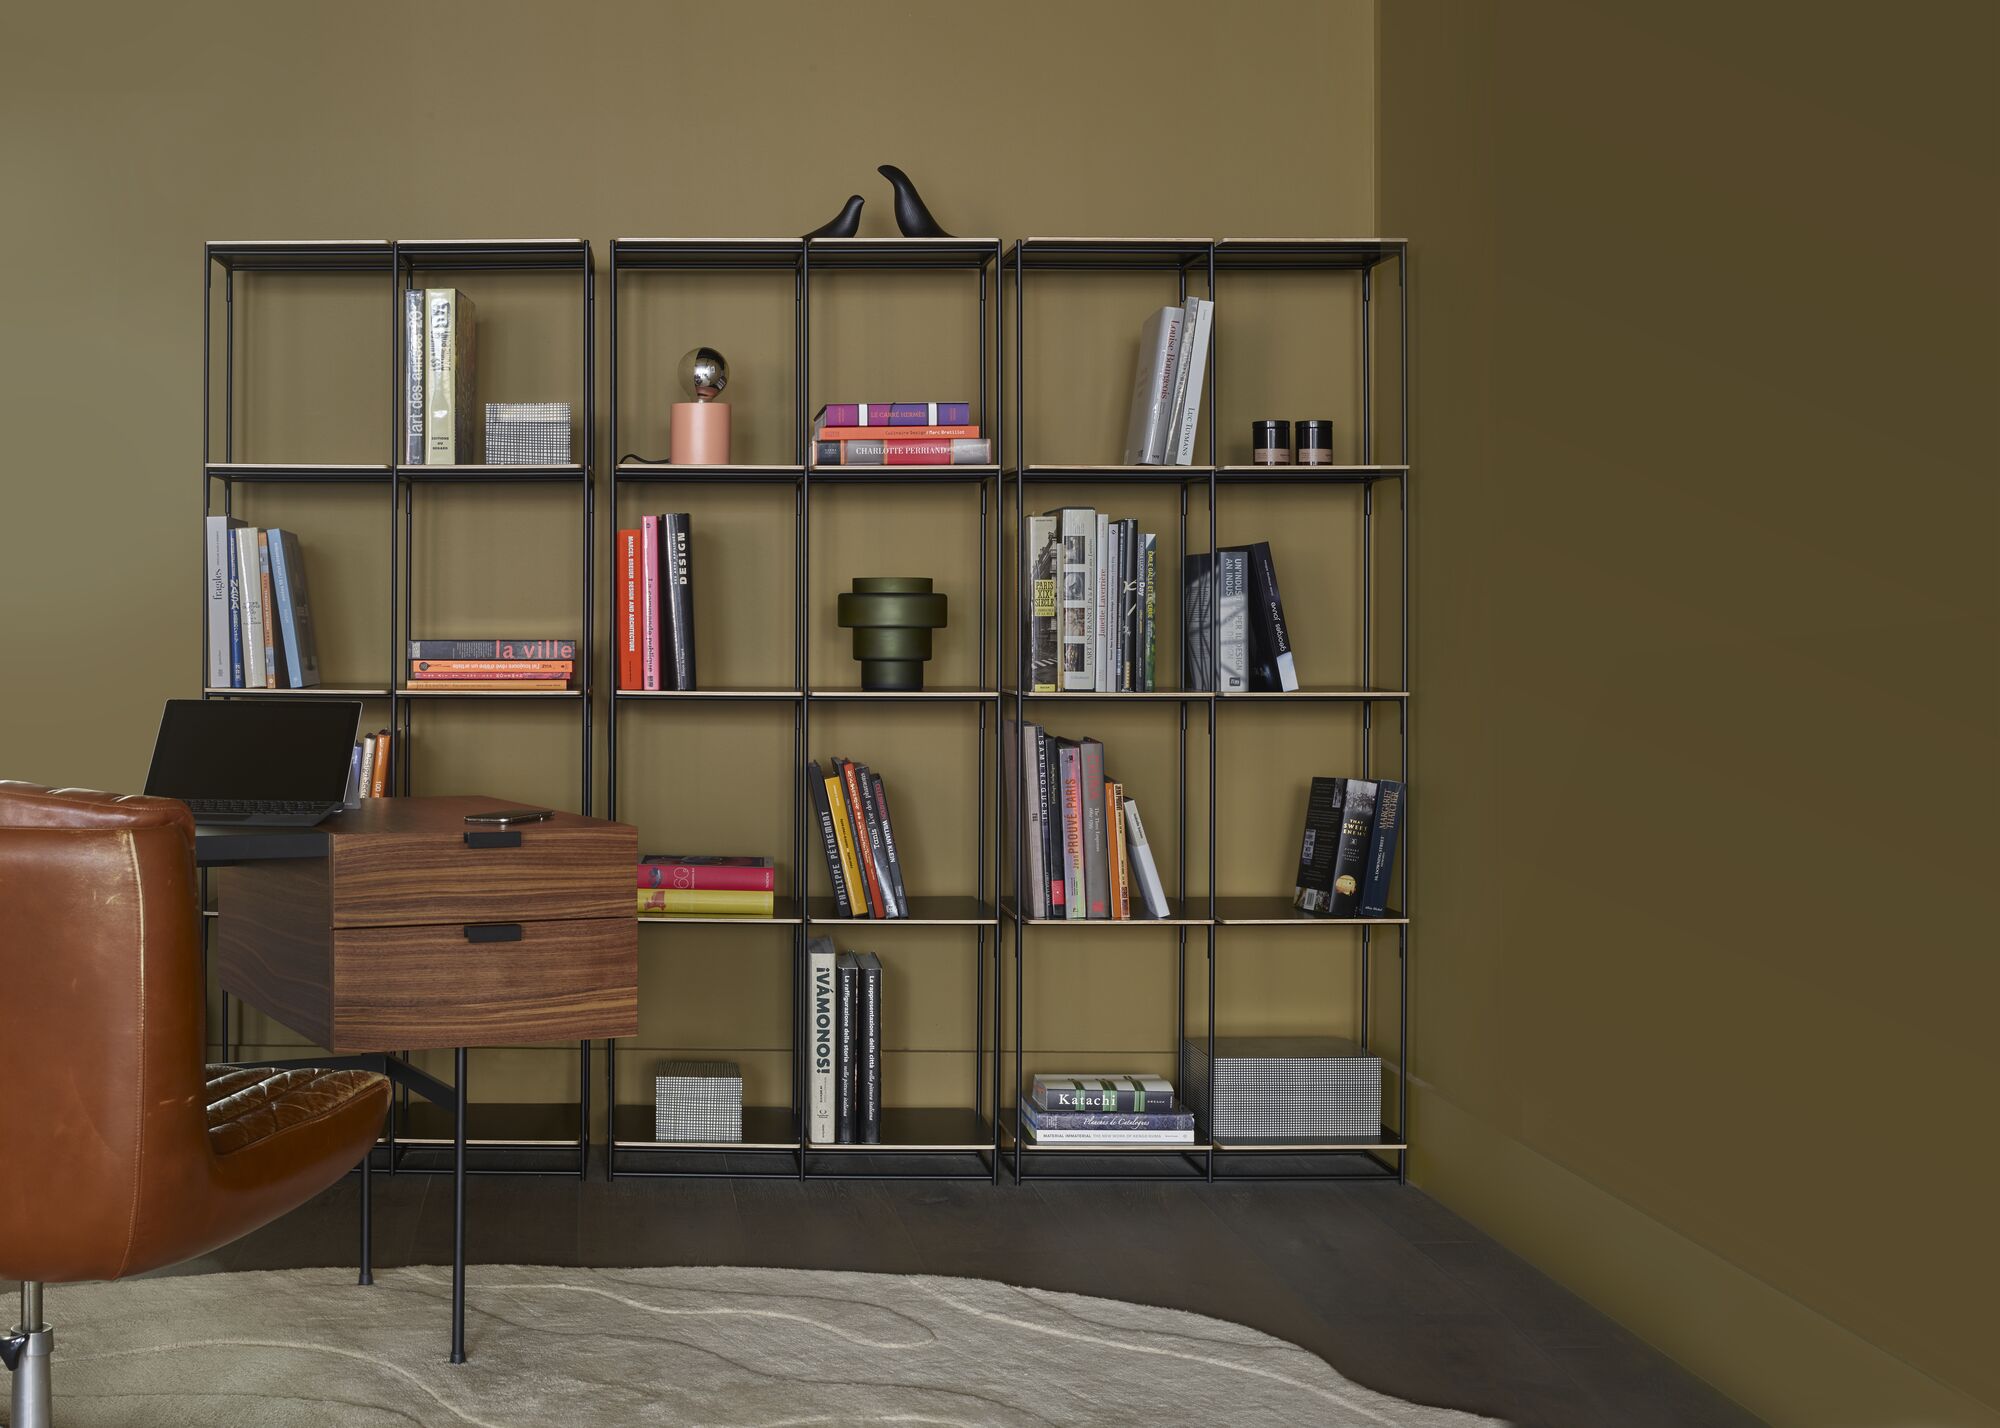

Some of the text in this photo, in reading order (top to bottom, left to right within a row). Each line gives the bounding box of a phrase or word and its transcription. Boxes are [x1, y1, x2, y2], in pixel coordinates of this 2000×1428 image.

[1161, 320, 1180, 399] Louise Bourgeois
[409, 385, 422, 408] des
[905, 446, 944, 455] PERRIAND
[678, 533, 687, 584] DESIGN
[1226, 558, 1233, 569] AN
[212, 569, 224, 600] fragiles
[230, 579, 239, 609] NASA
[1270, 602, 1287, 652] georges jouve
[496, 640, 514, 658] la
[523, 640, 572, 658] ville
[1038, 735, 1046, 768] ISAMU
[1065, 778, 1076, 808] PARIS
[1379, 789, 1391, 829] MARGARET
[882, 820, 892, 844] WILLIAM
[1065, 813, 1079, 854] PROUVÉ
[821, 810, 847, 905] PHILIPPE PÉTREMANT
[816, 967, 833, 1074] ¡VÁMONOS!
[1059, 1094, 1116, 1106] Katachi
